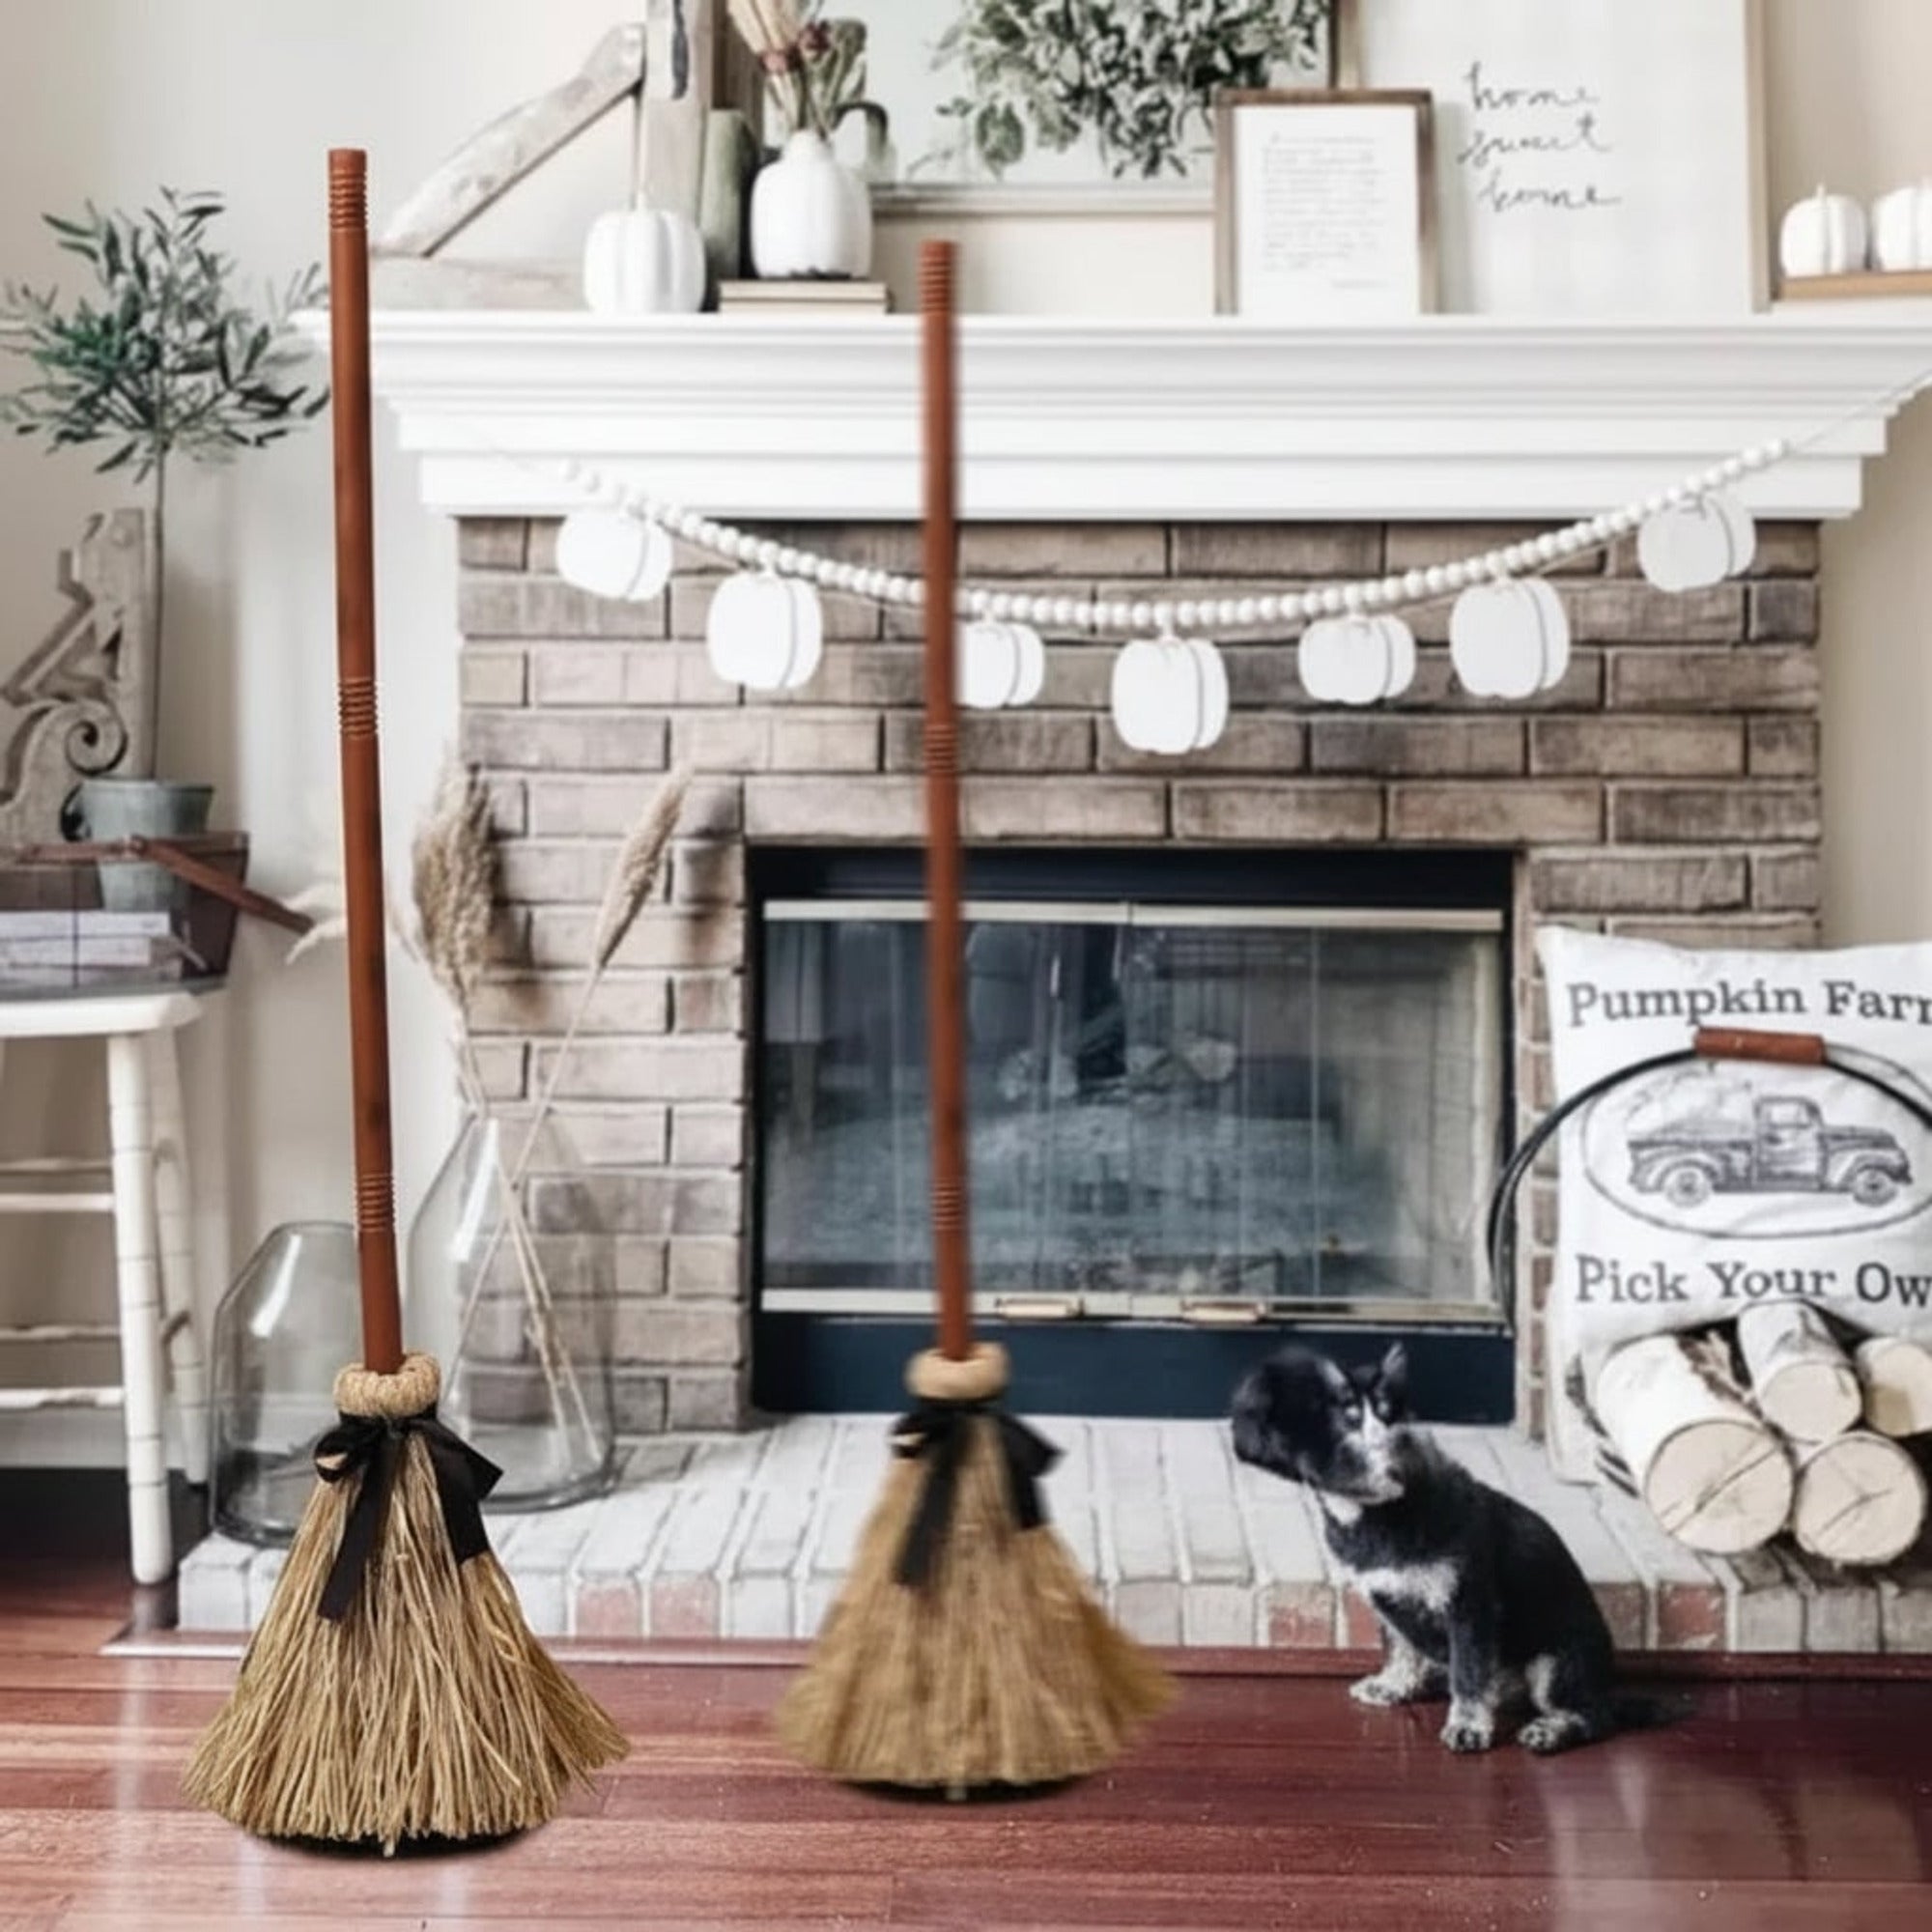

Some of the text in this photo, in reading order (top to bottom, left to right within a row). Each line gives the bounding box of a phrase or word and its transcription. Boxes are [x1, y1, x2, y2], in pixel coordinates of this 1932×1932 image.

[1463, 61, 1600, 110] home
[1479, 166, 1621, 213] home
[1567, 979, 1806, 1027] Pumpkin
[1576, 1255, 1689, 1301] Pick
[1706, 1263, 1836, 1298] Your
